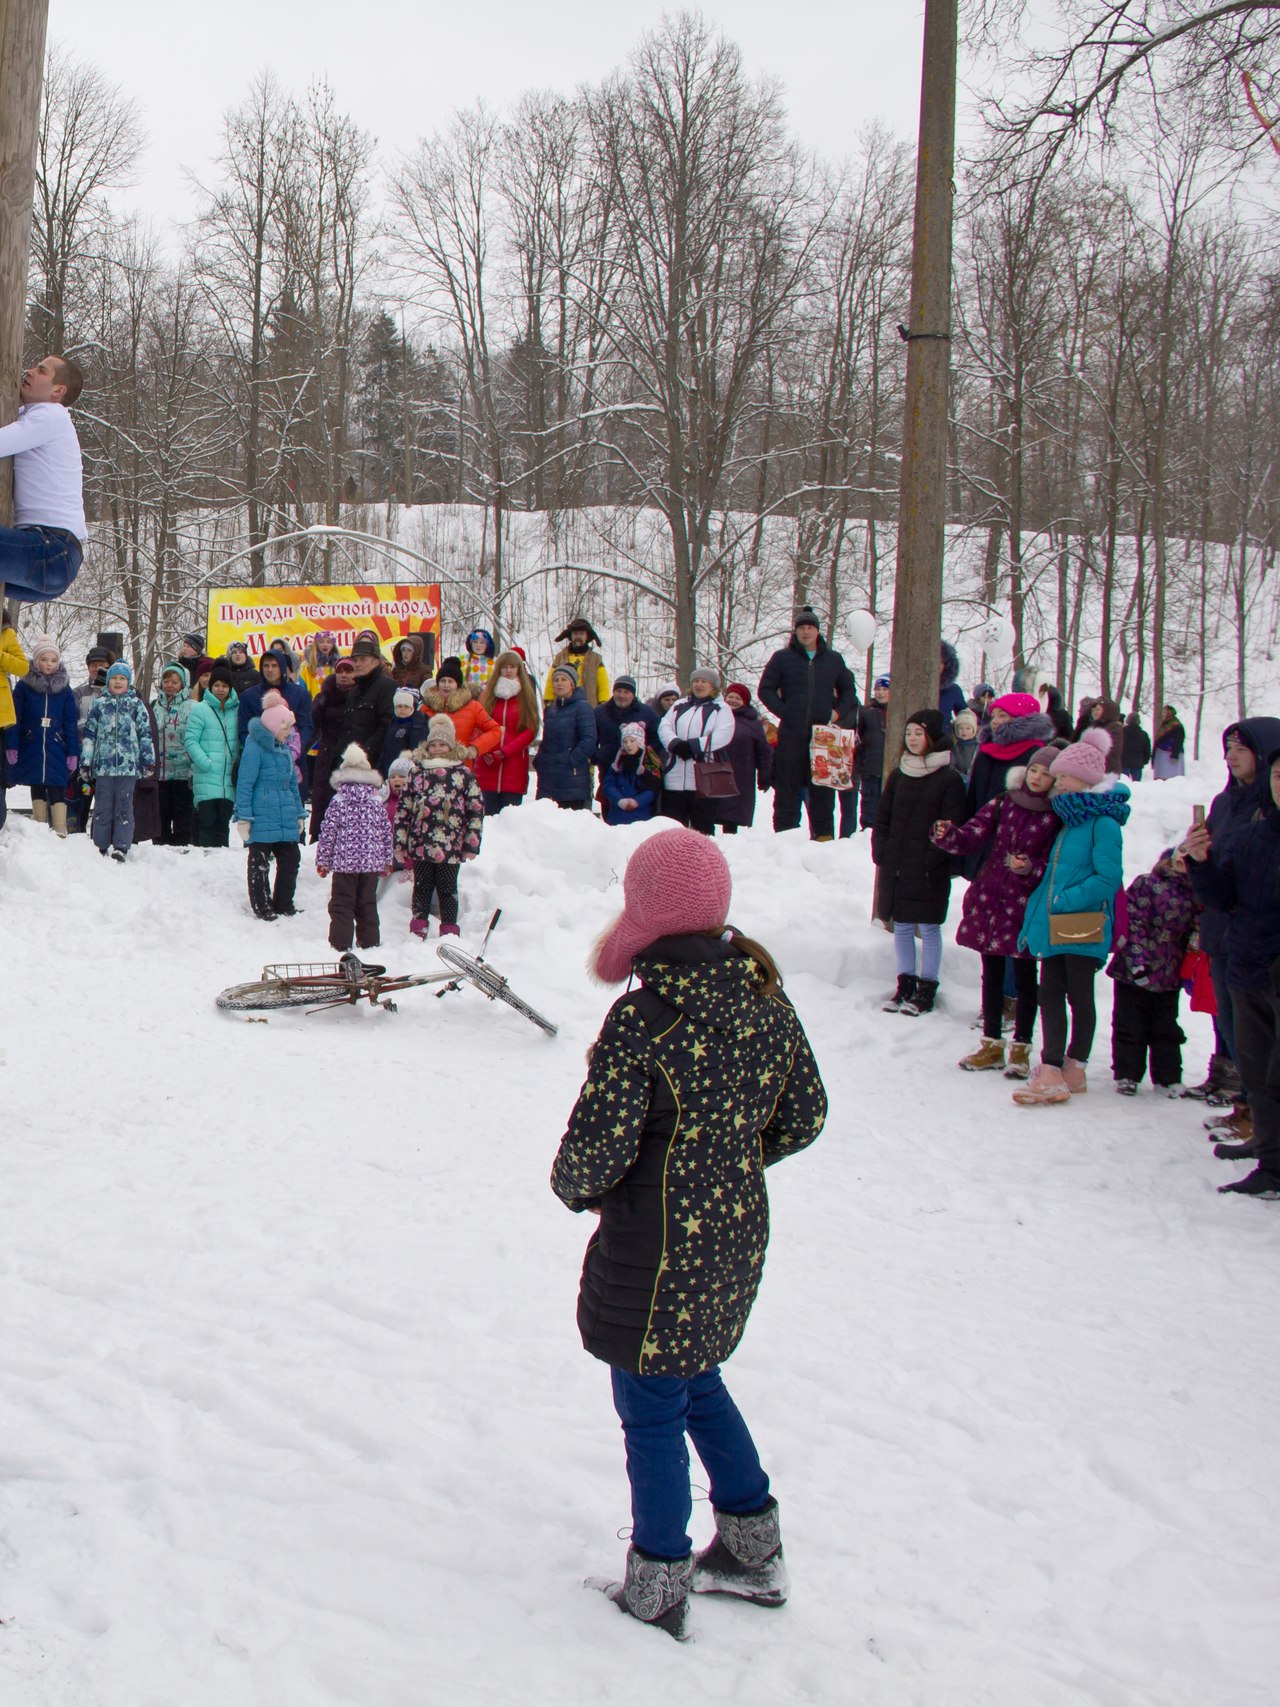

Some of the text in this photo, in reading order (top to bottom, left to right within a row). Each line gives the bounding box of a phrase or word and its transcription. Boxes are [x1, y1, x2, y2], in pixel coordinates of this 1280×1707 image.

[220, 600, 435, 625] Приходи честной народ,
